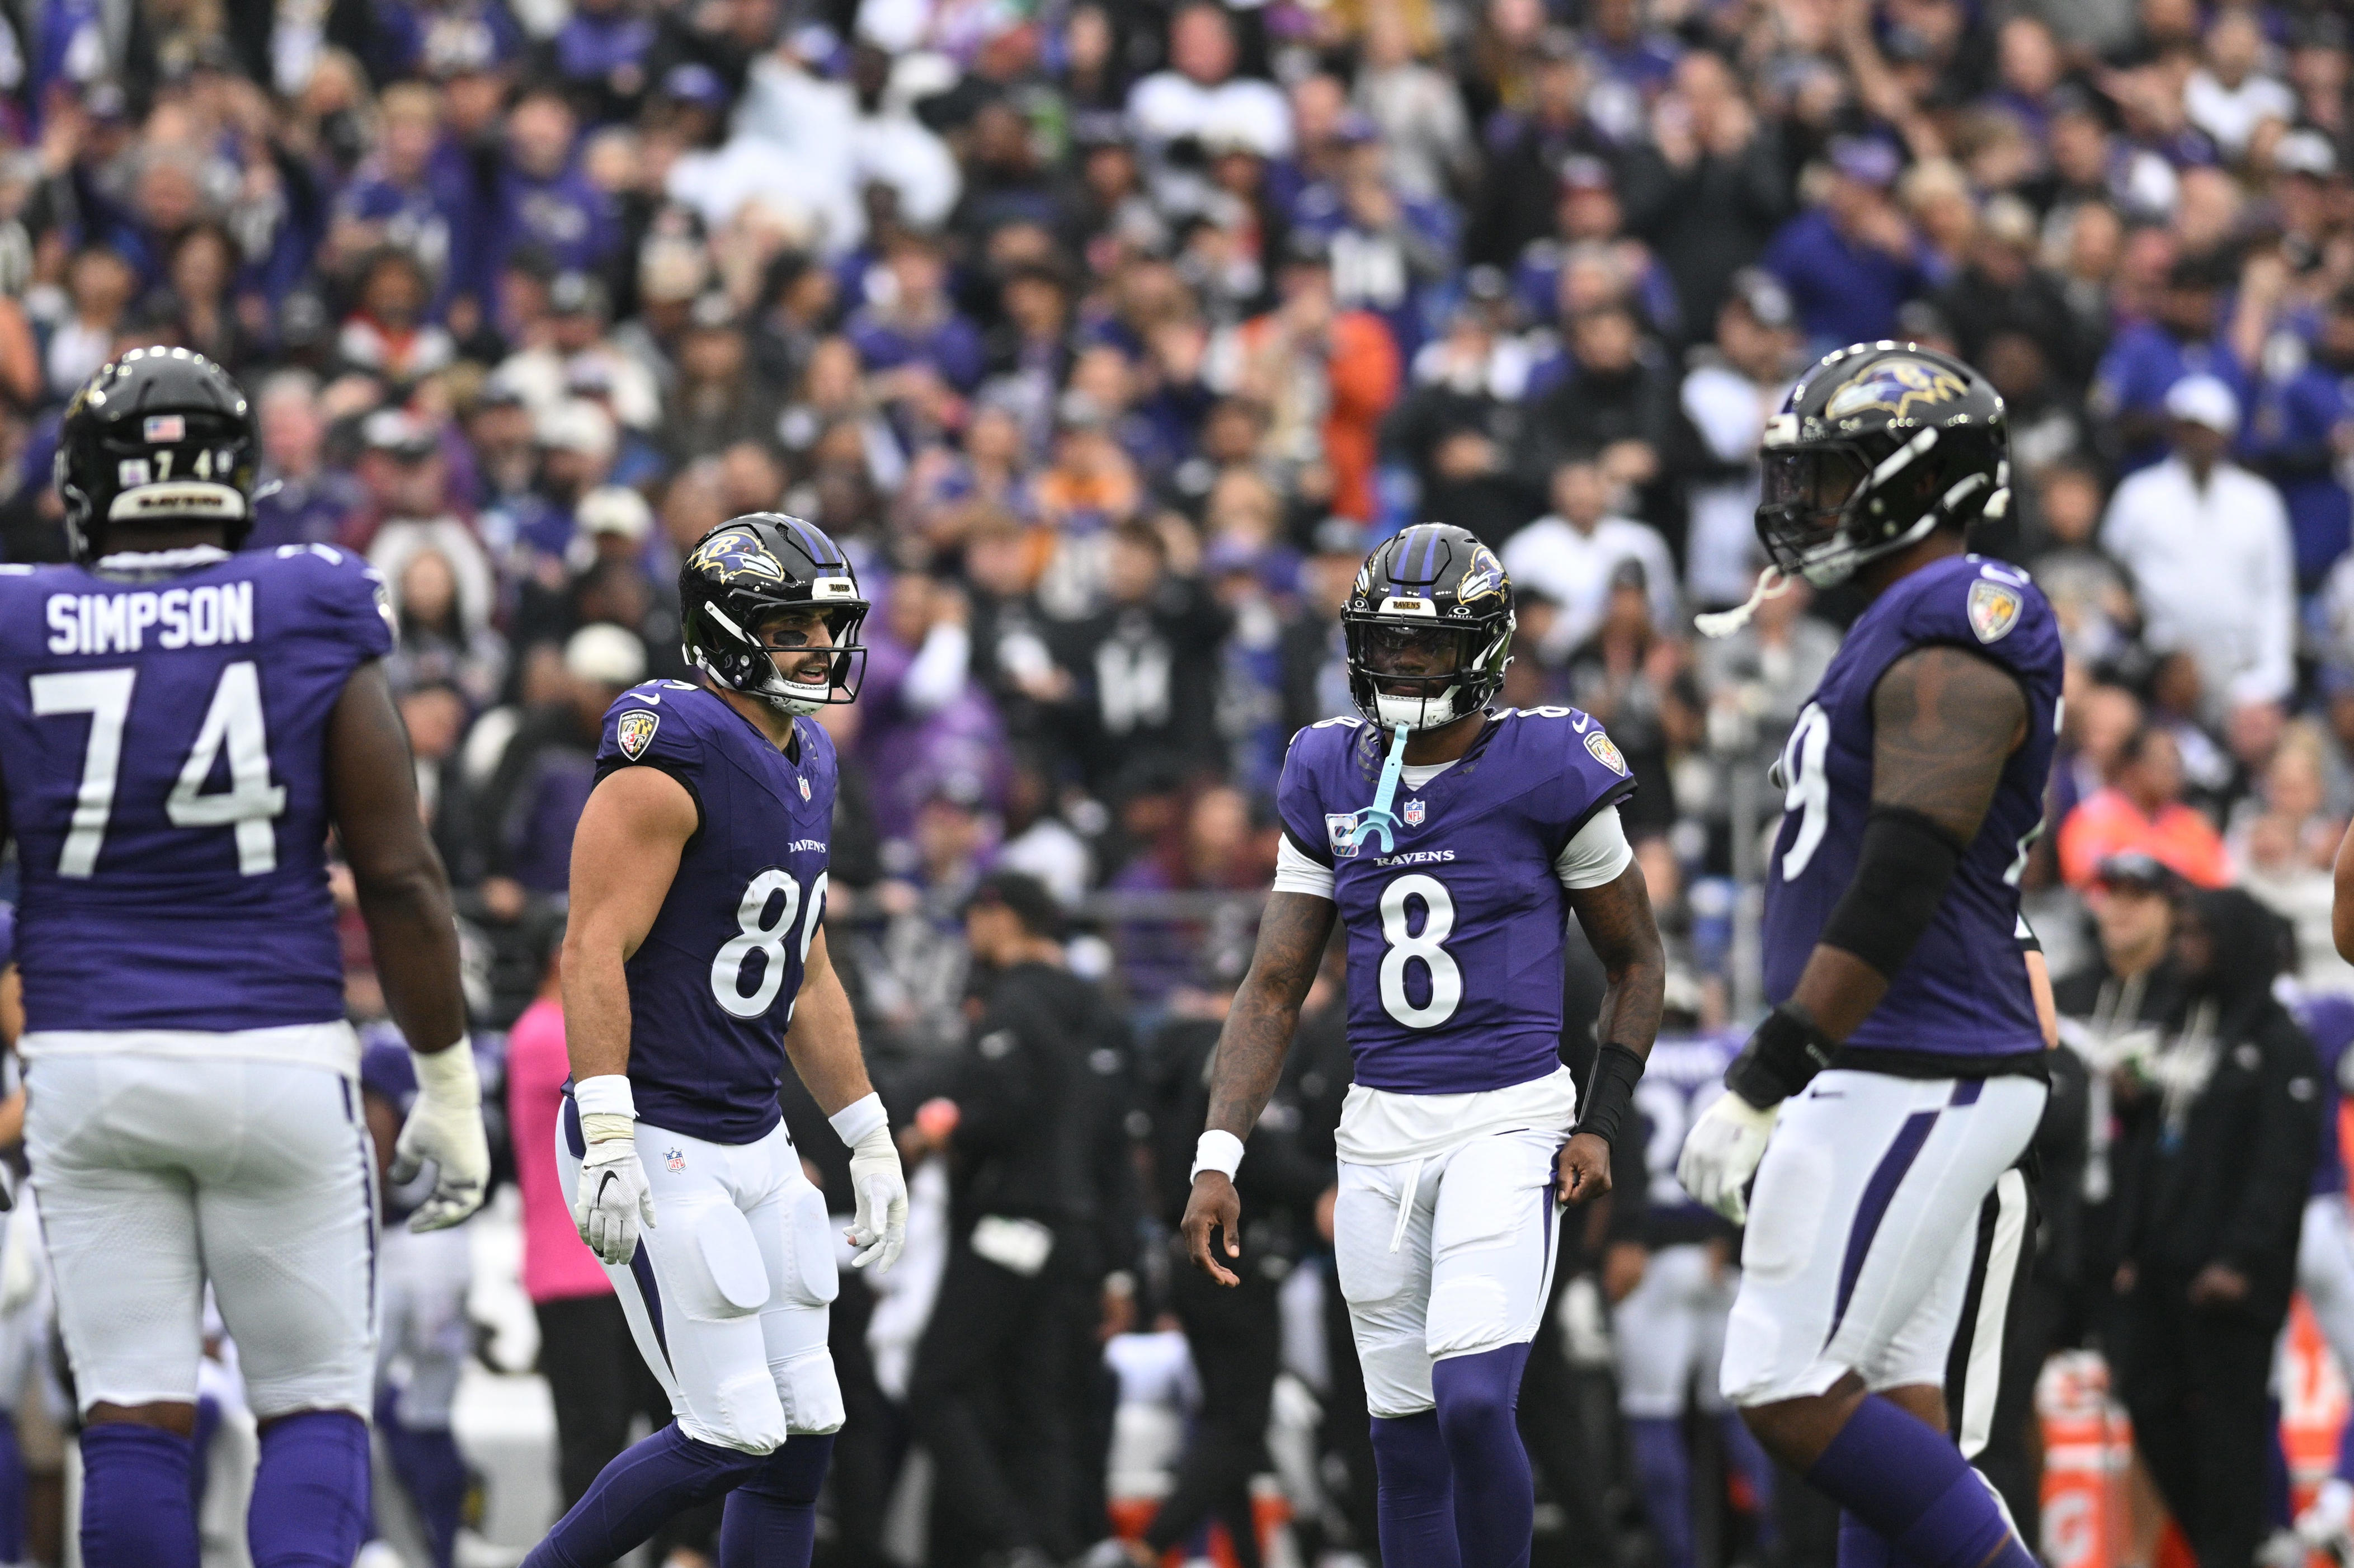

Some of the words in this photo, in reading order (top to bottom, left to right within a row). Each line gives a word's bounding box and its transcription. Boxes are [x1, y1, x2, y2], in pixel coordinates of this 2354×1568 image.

[1392, 601, 1421, 610] RAVENS
[46, 581, 253, 654] SIMPSON
[622, 714, 655, 722] RAVENS
[29, 660, 287, 879] 74
[1768, 701, 1829, 882] 9
[1407, 811, 1421, 821] NFL
[1373, 850, 1455, 867] RAVENS
[1379, 874, 1462, 1029] 8
[669, 1158, 684, 1169] NFL
